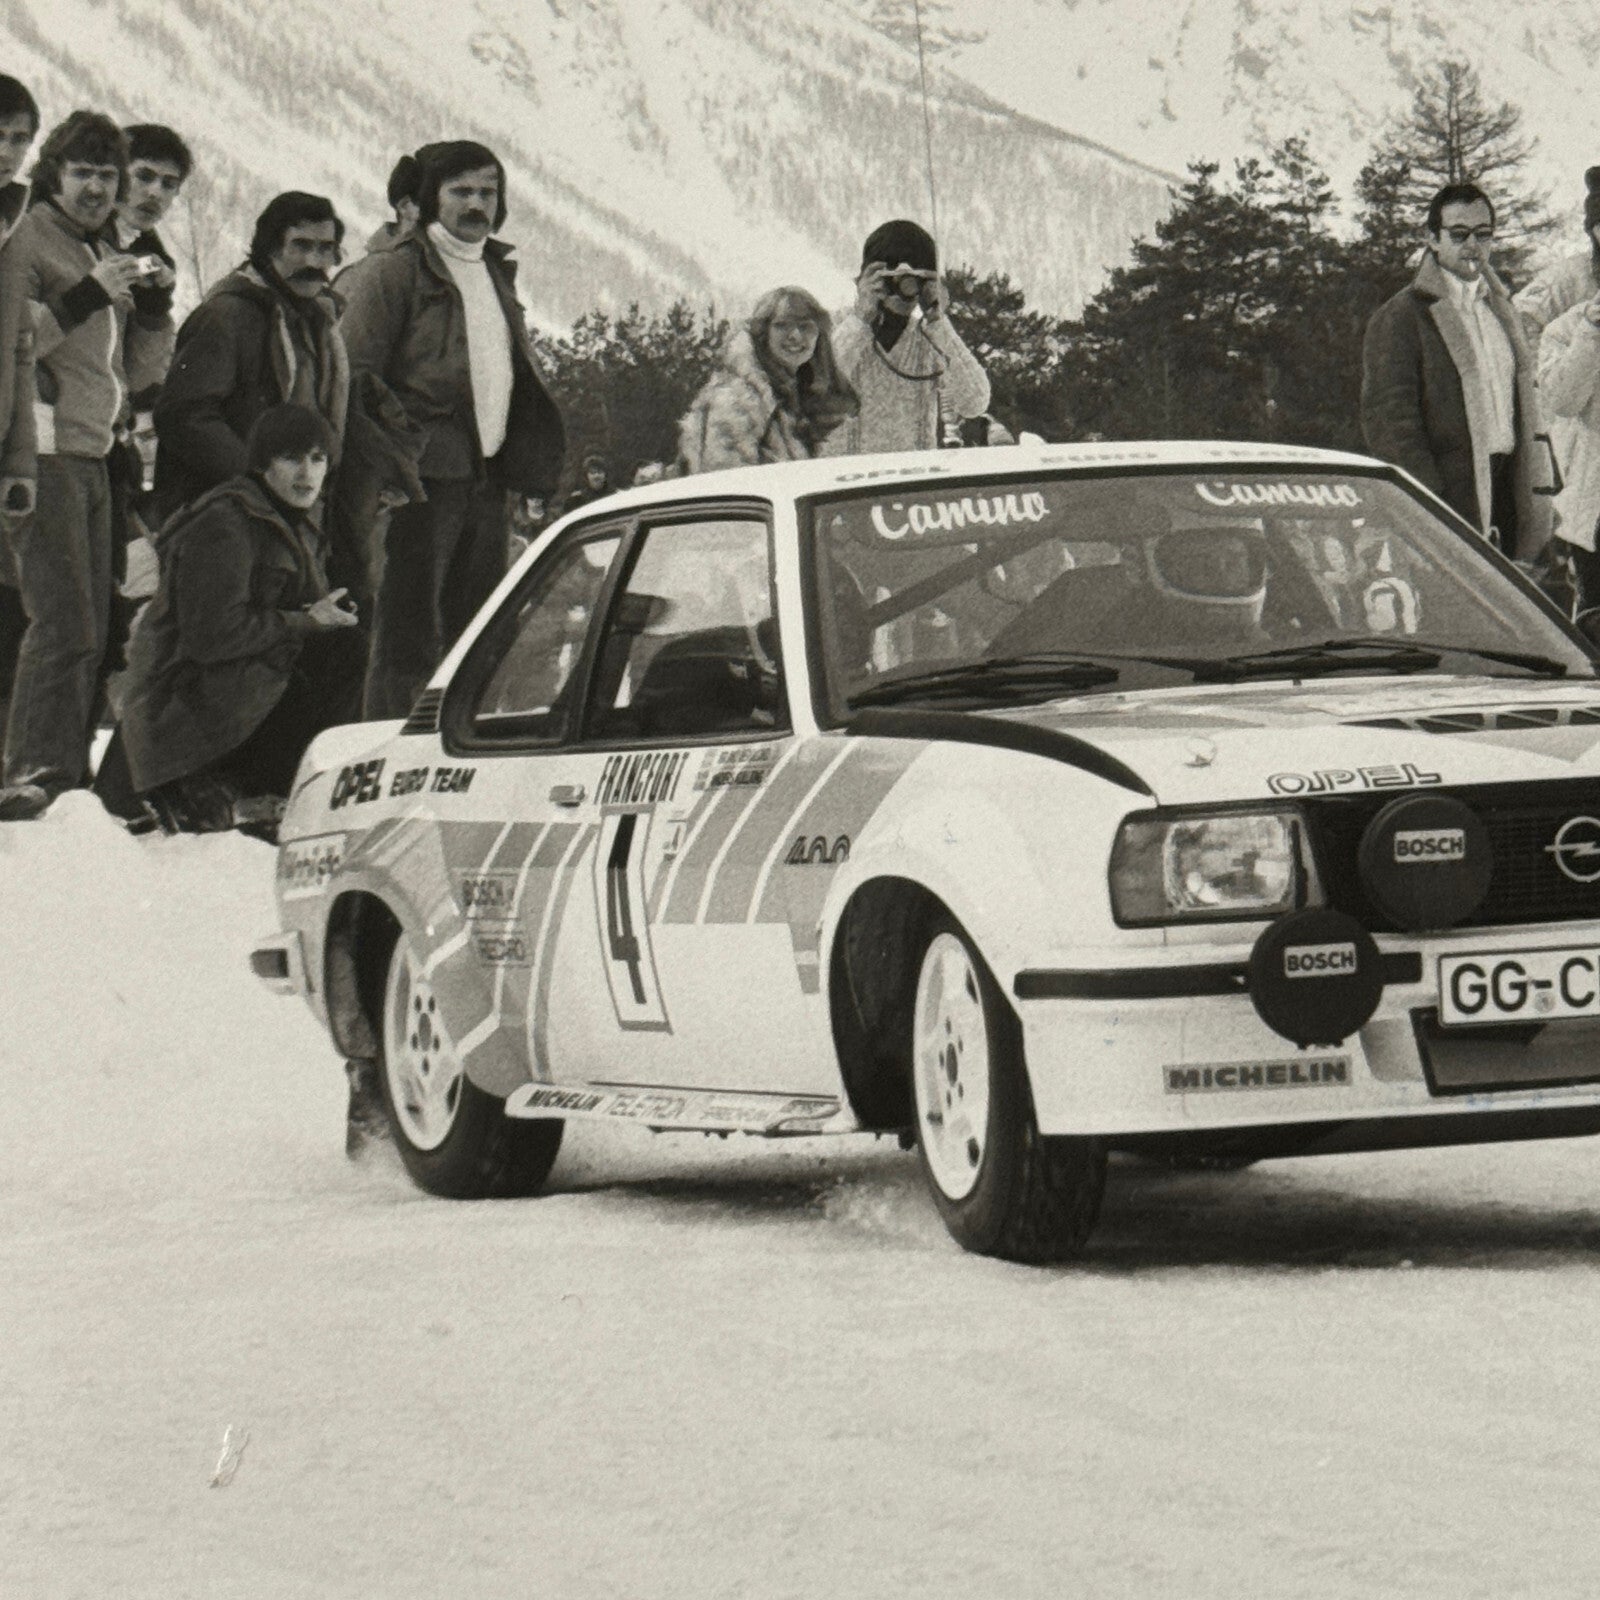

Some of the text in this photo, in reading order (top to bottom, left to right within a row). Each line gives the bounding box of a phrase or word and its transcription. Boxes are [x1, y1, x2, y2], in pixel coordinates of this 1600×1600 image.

[1195, 482, 1363, 507] Camino
[871, 492, 1051, 540] Camino
[330, 757, 386, 811] OPEL
[430, 767, 477, 793] TEAM
[1266, 763, 1443, 795] OPEL
[1397, 836, 1463, 857] BOSCH
[1287, 951, 1354, 972] BOSCH
[1451, 956, 1600, 1015] GG-C
[1169, 1062, 1346, 1089] MICHELIN
[525, 1089, 605, 1112] MICHELIN
